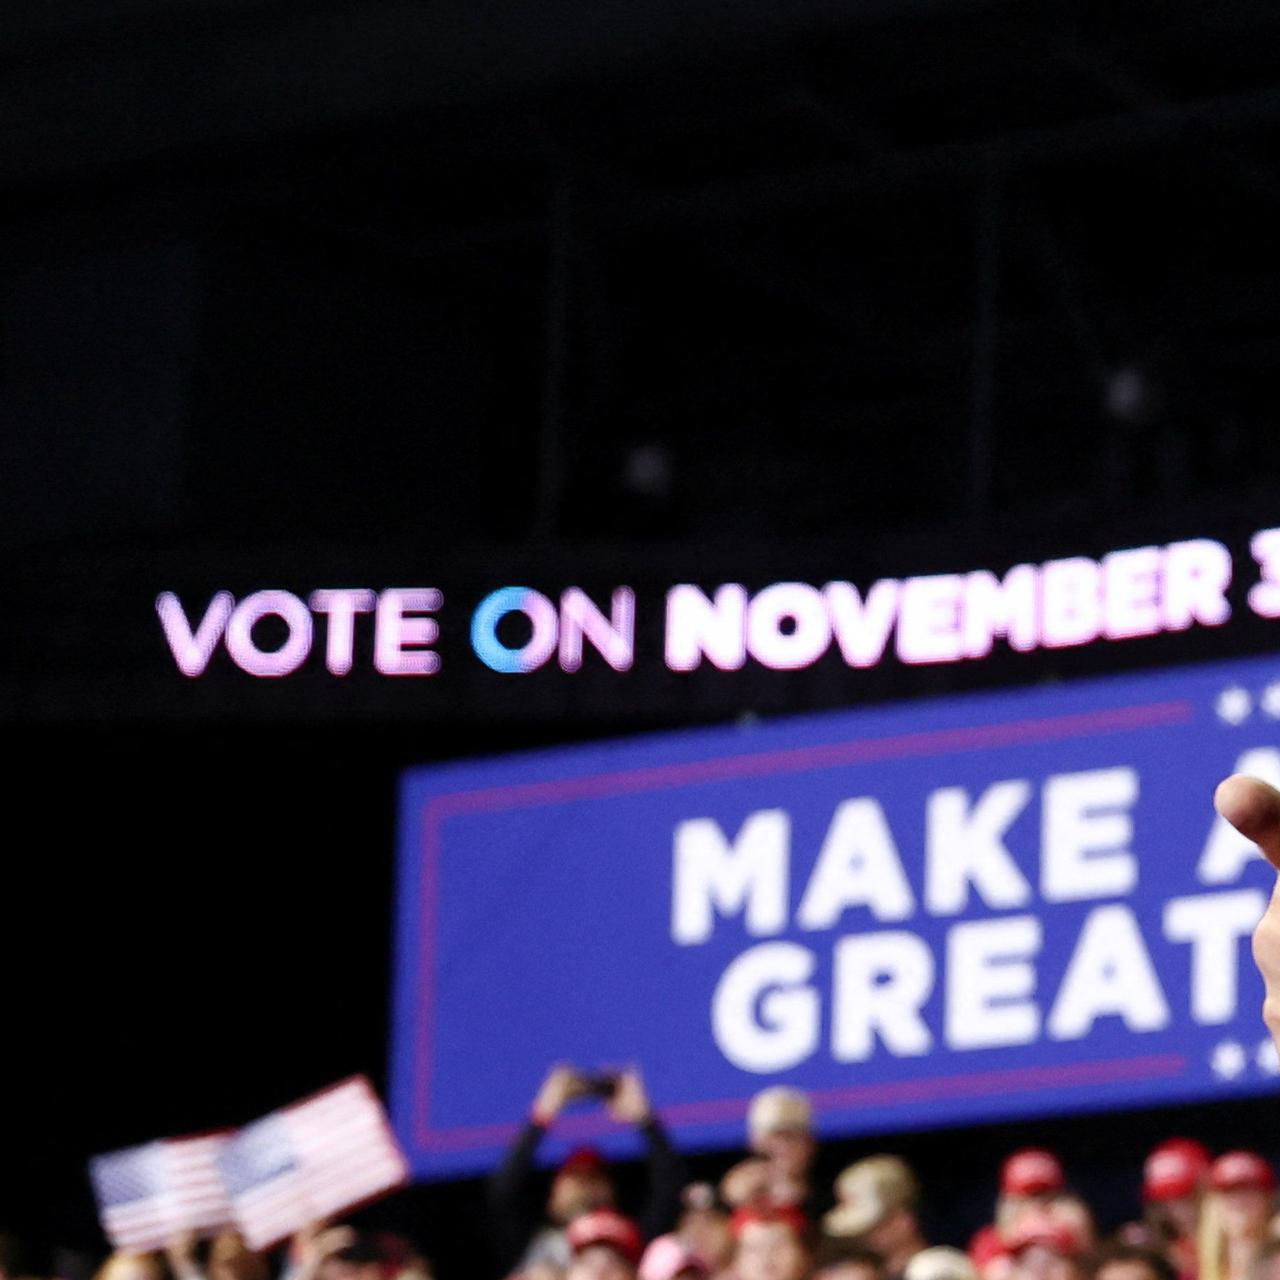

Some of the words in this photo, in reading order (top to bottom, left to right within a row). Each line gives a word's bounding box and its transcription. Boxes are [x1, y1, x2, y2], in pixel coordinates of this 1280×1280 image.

[156, 587, 442, 676] VOTE
[470, 586, 635, 674] ON
[665, 538, 1232, 671] NOVEMBER
[671, 766, 1139, 945] MAKE
[711, 891, 1263, 1074] GREAT
